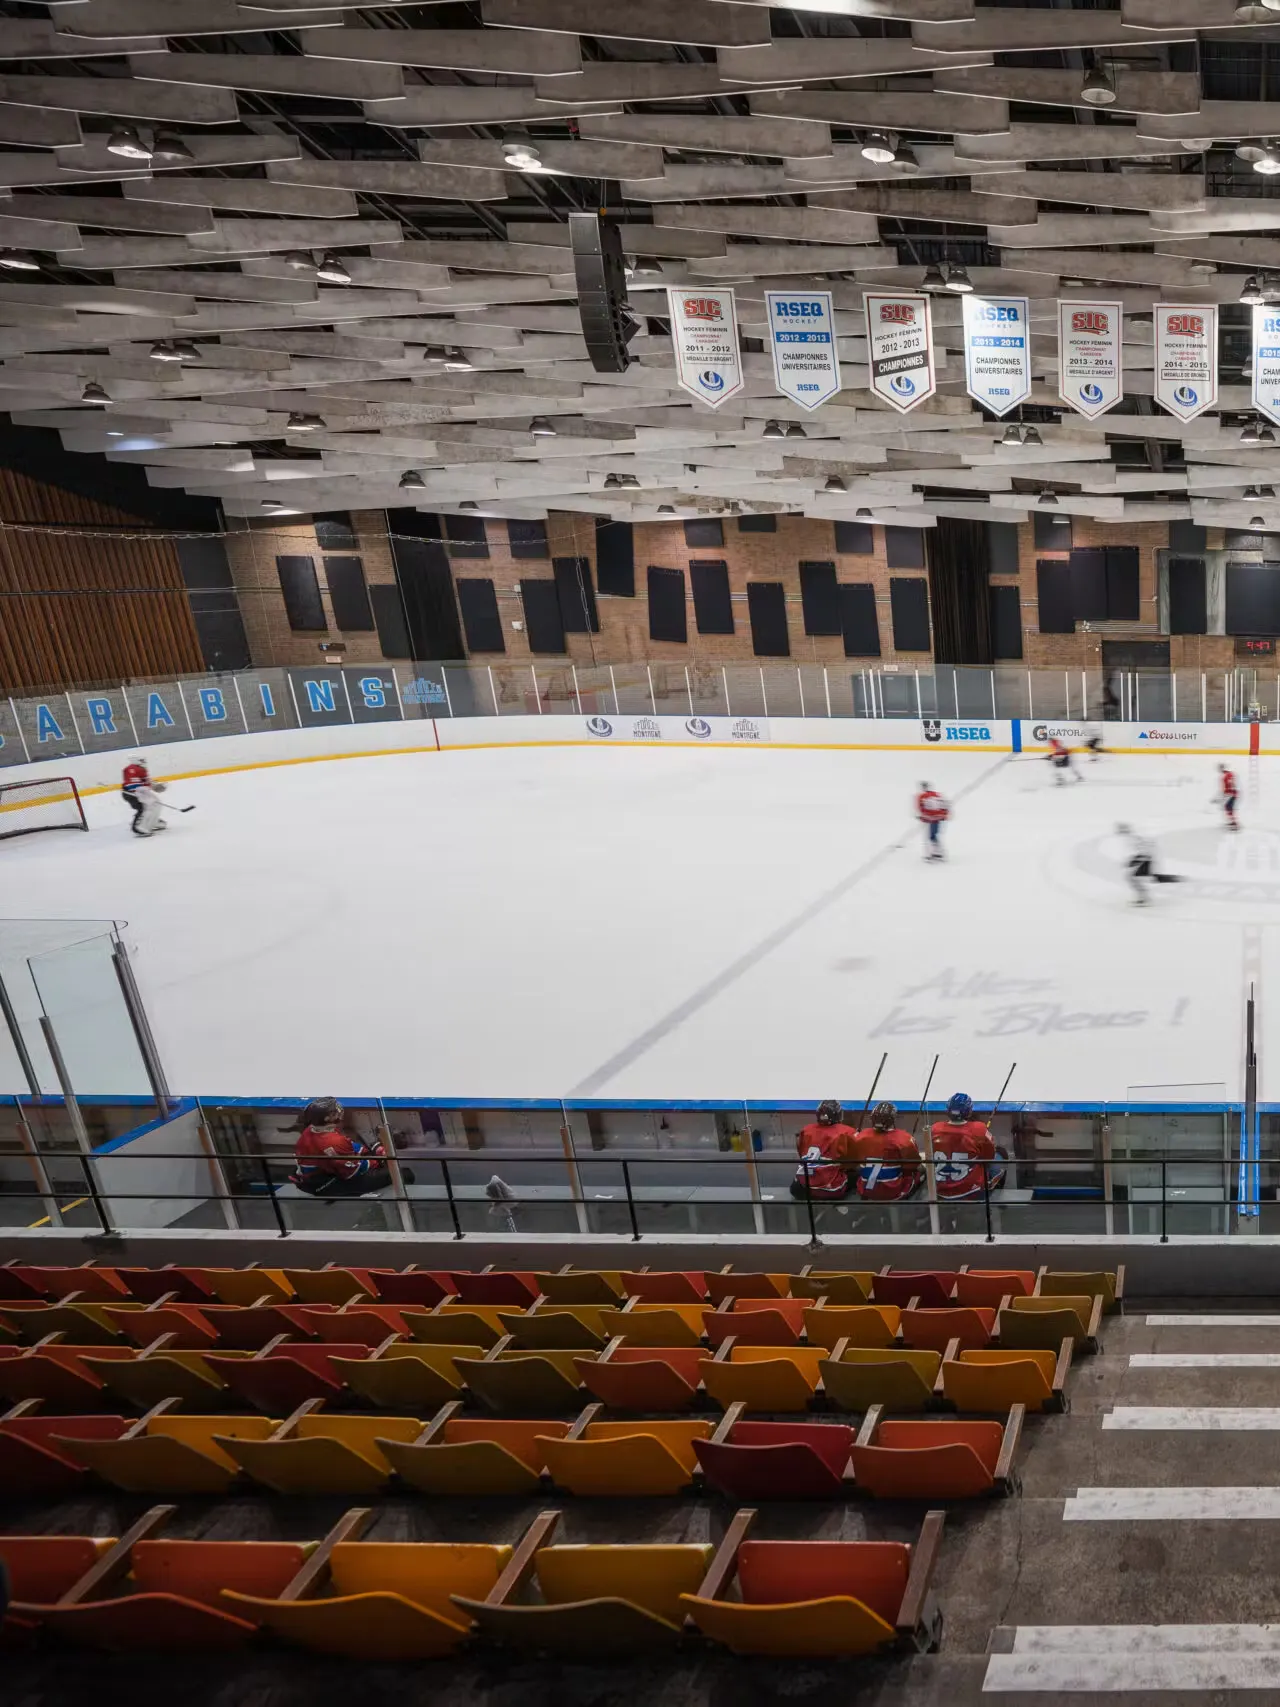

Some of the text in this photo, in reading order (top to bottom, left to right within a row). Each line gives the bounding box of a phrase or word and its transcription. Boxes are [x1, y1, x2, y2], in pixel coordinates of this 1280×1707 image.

[683, 298, 722, 317] SIC
[776, 302, 824, 316] RSEQ
[880, 304, 915, 321] SIC
[1072, 311, 1109, 330] SIC
[1167, 314, 1204, 333] SIC
[780, 334, 800, 342] 2012
[806, 334, 826, 342] 2013
[875, 332, 897, 341] HOCKEY
[974, 338, 994, 346] 2013
[882, 342, 898, 353] 2012
[904, 338, 920, 350] 2013
[782, 353, 828, 361] CHAMPIONNES
[879, 355, 924, 373] CHAMPIONNES
[976, 357, 1021, 365] CHAMPIONNES
[781, 363, 831, 371] UNIVERSITAIRES
[974, 367, 1023, 375] UNIVERSITAIRES
[0, 677, 386, 749] ARABINS
[945, 727, 992, 740] RSEQ
[1149, 730, 1174, 740] Coors
[865, 1157, 884, 1190] 7
[934, 1151, 973, 1182] 25
